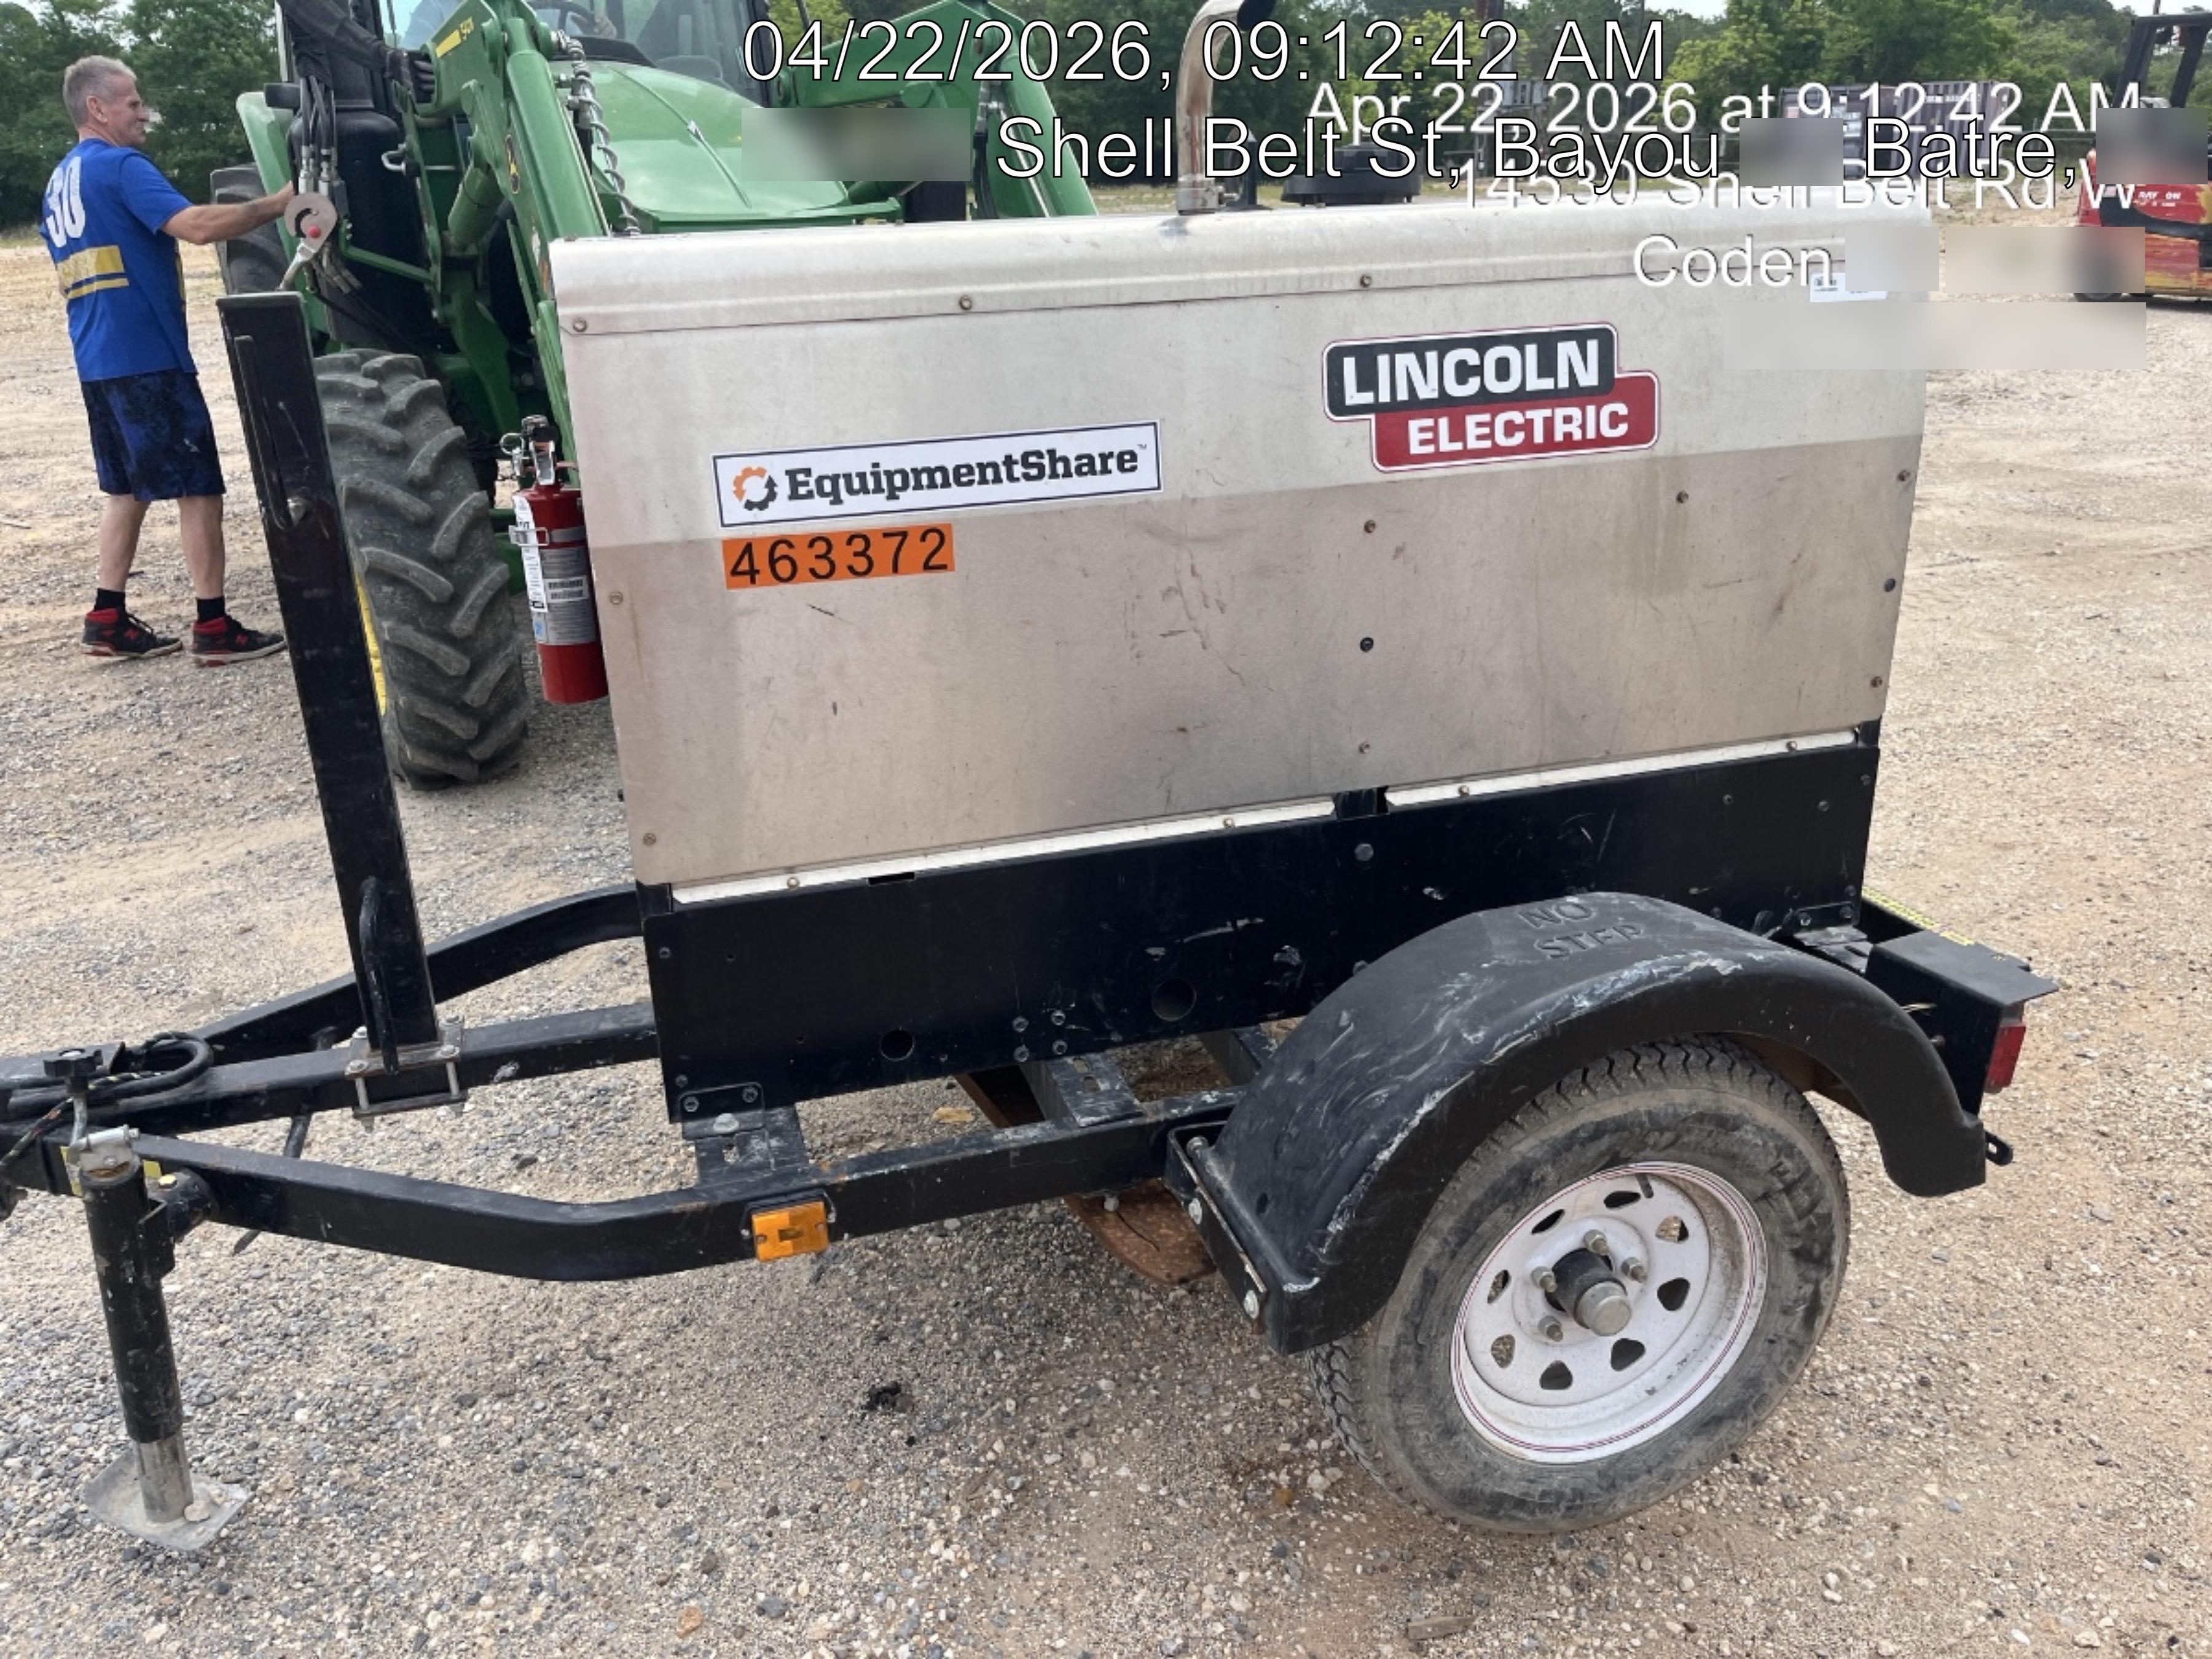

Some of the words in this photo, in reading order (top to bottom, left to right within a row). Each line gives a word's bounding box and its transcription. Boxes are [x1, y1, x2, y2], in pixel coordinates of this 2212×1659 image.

[45, 156, 85, 248] 30
[1343, 339, 1599, 406] LINCOLN
[1408, 402, 1629, 455] ELECTRIC
[785, 448, 1139, 505] EquipmentShare
[730, 527, 949, 586] 463372
[1518, 902, 1596, 929] NO
